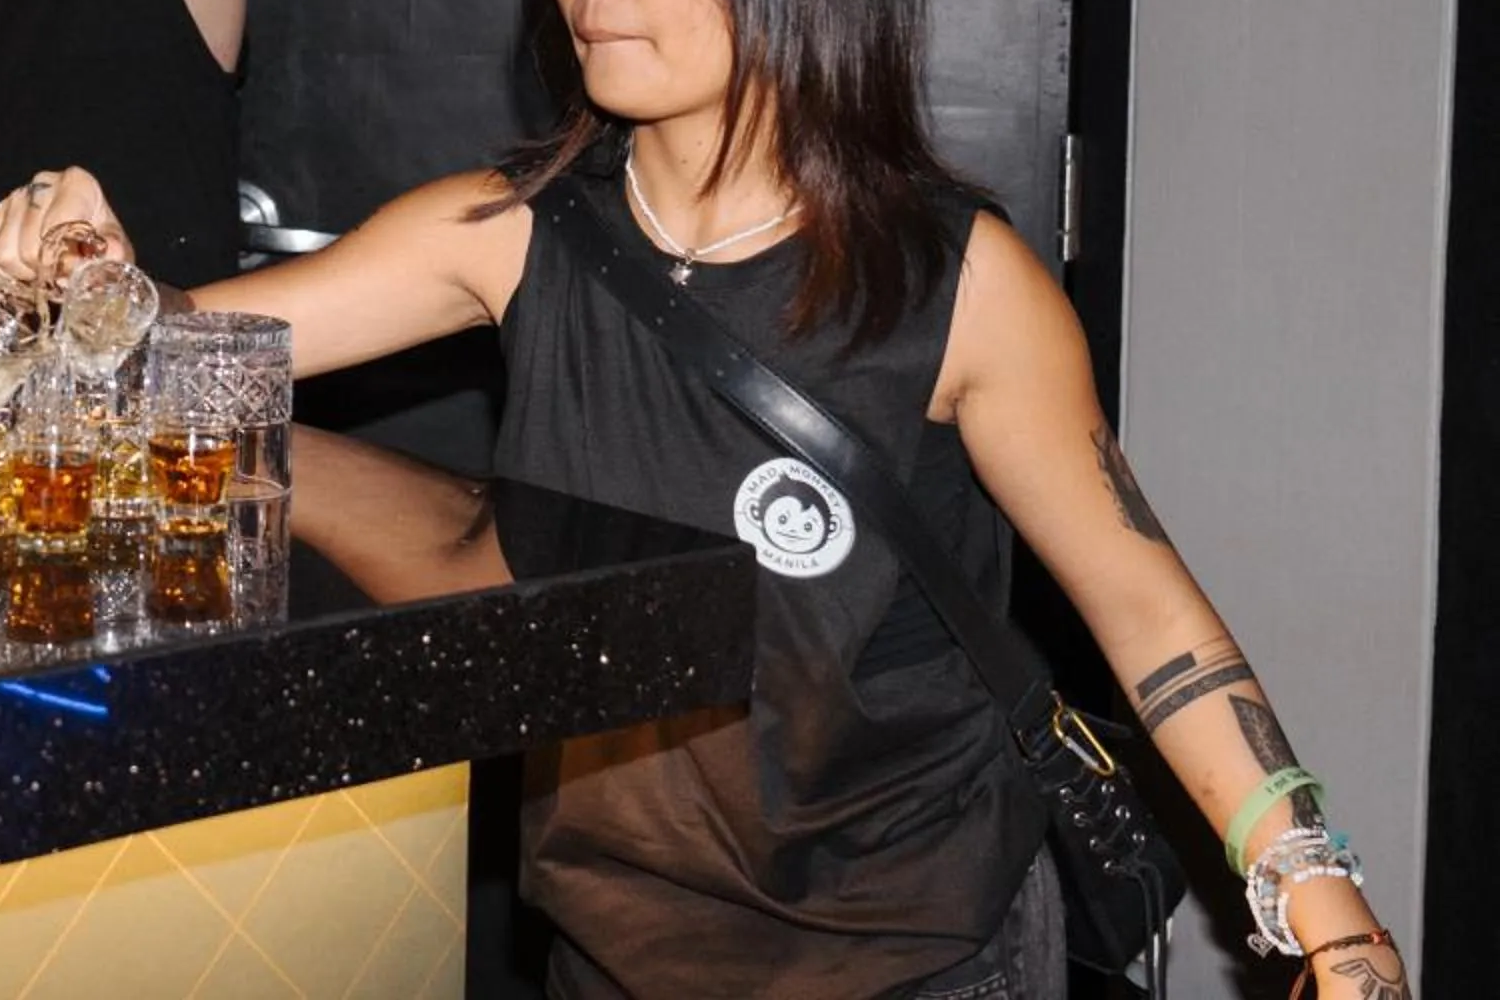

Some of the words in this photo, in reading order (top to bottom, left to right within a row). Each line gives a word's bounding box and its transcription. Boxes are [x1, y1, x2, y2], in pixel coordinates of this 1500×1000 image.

[747, 466, 778, 494] MAD
[789, 464, 841, 508] MONKEY
[762, 548, 820, 570] MANILA
